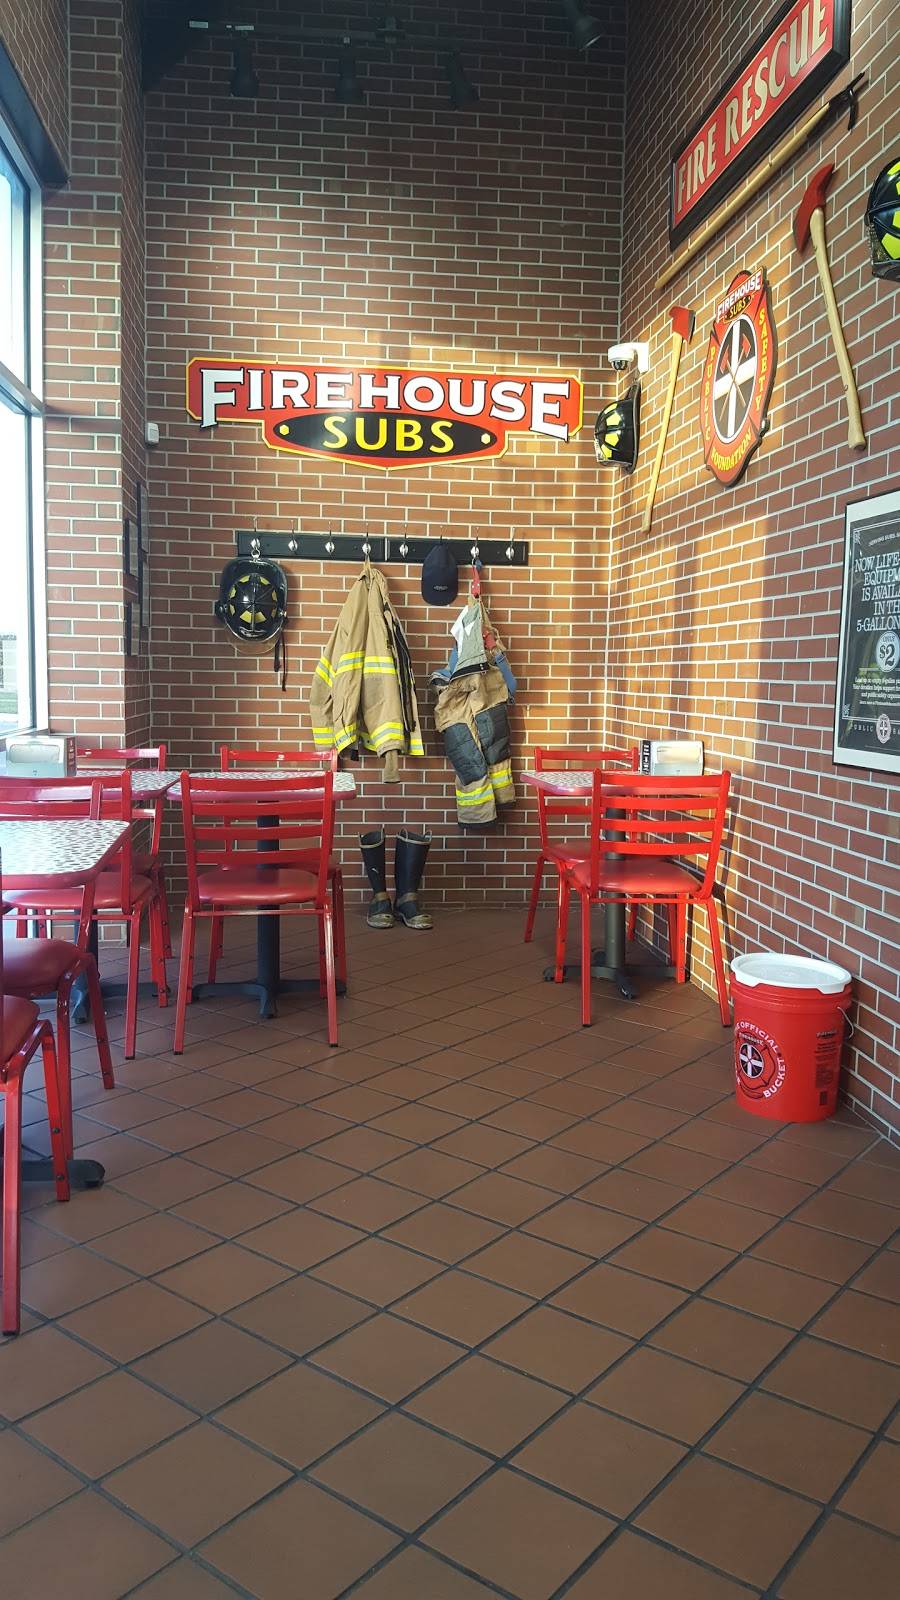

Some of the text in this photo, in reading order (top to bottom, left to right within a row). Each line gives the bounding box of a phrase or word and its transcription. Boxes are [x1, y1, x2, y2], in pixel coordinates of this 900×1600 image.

[677, 0, 828, 212] FIRE RESCUE
[717, 270, 762, 323] FIREHOUSE
[729, 297, 747, 318] SUBS
[755, 308, 769, 411] SAFETY
[200, 367, 572, 443] FIREHOUSE
[703, 346, 716, 441] PUBLIC
[322, 416, 455, 453] SUBS
[711, 427, 752, 471] FOUNDATION
[855, 556, 875, 573] NOW
[861, 587, 870, 601] IS
[873, 601, 885, 616] IN
[880, 643, 896, 667] $2
[740, 1021, 778, 1053] OFFICIAL
[763, 1056, 786, 1098] BUCKET
